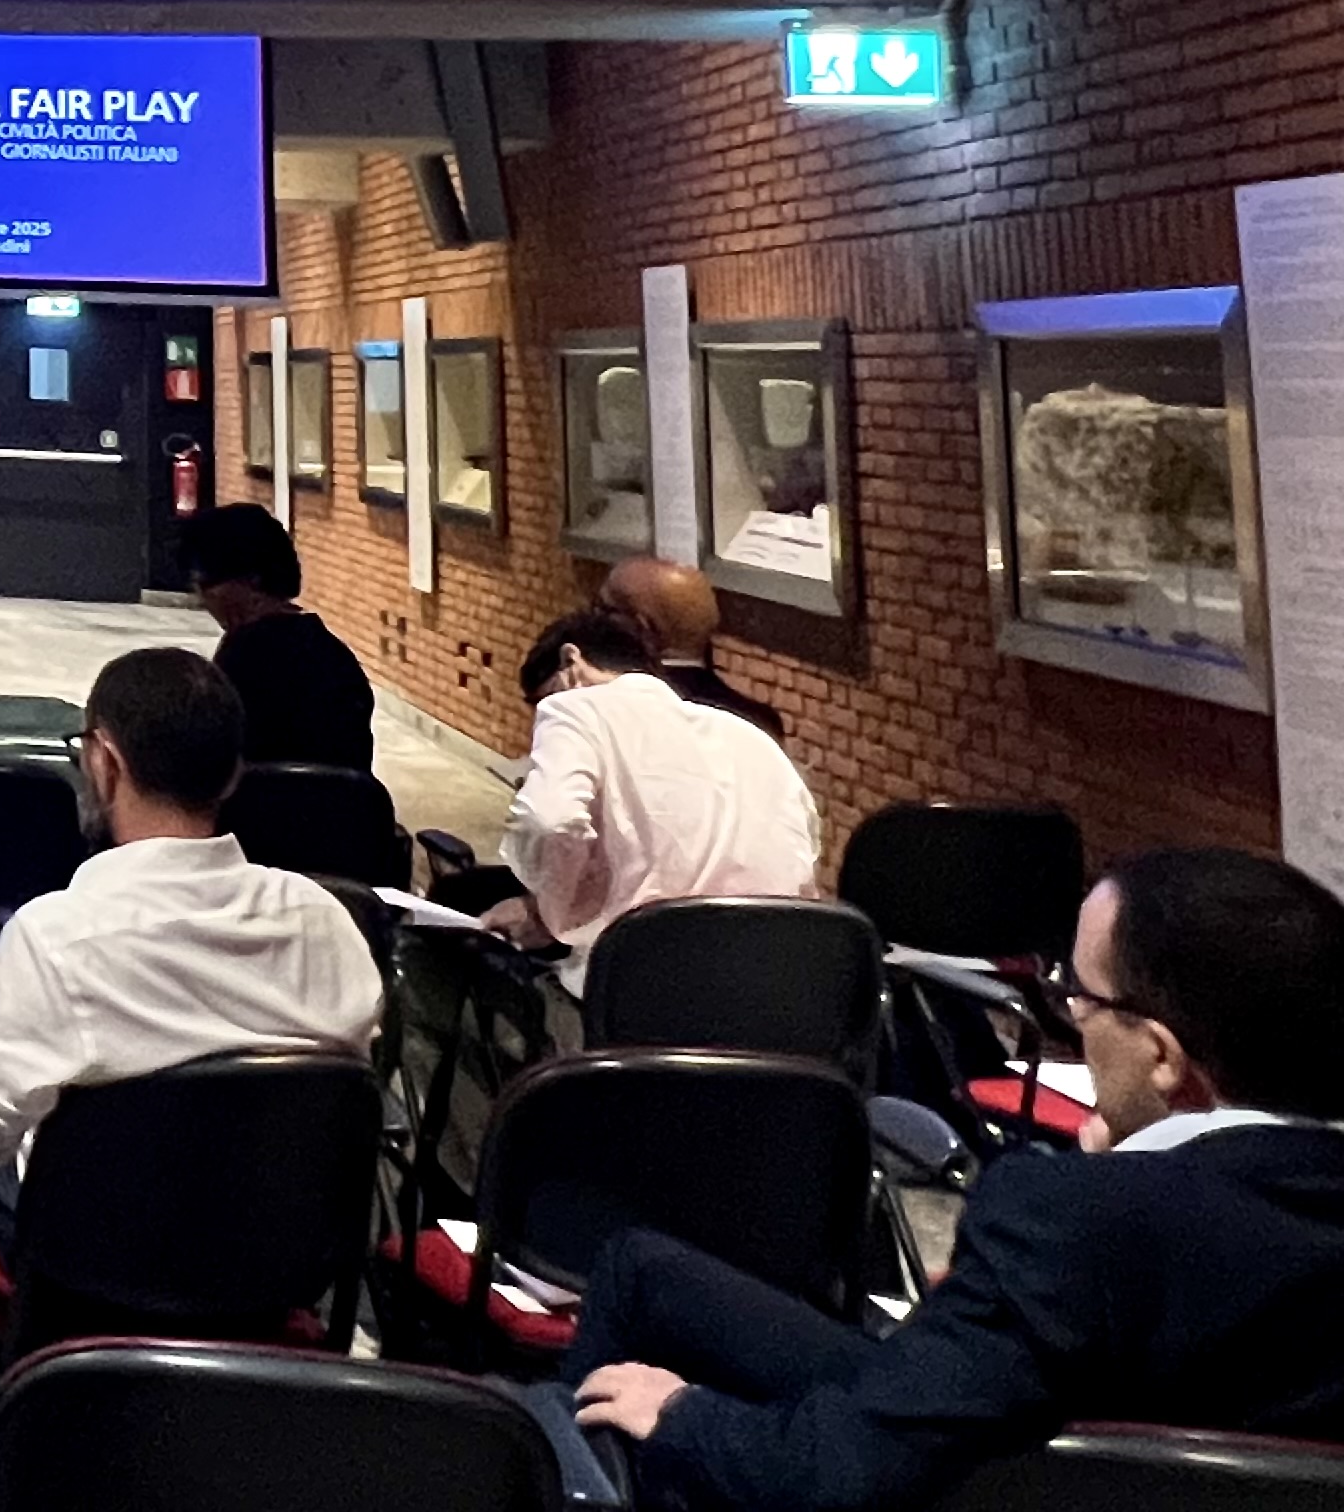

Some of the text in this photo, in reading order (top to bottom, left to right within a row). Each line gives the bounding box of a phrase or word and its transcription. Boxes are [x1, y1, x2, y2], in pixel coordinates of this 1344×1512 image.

[10, 88, 94, 121] FAIR
[102, 90, 200, 124] PLAY
[61, 124, 138, 142] POLITICA
[0, 142, 104, 161] GIORNALISTI
[108, 145, 178, 162] ITALIANI
[10, 221, 52, 237] 2025
